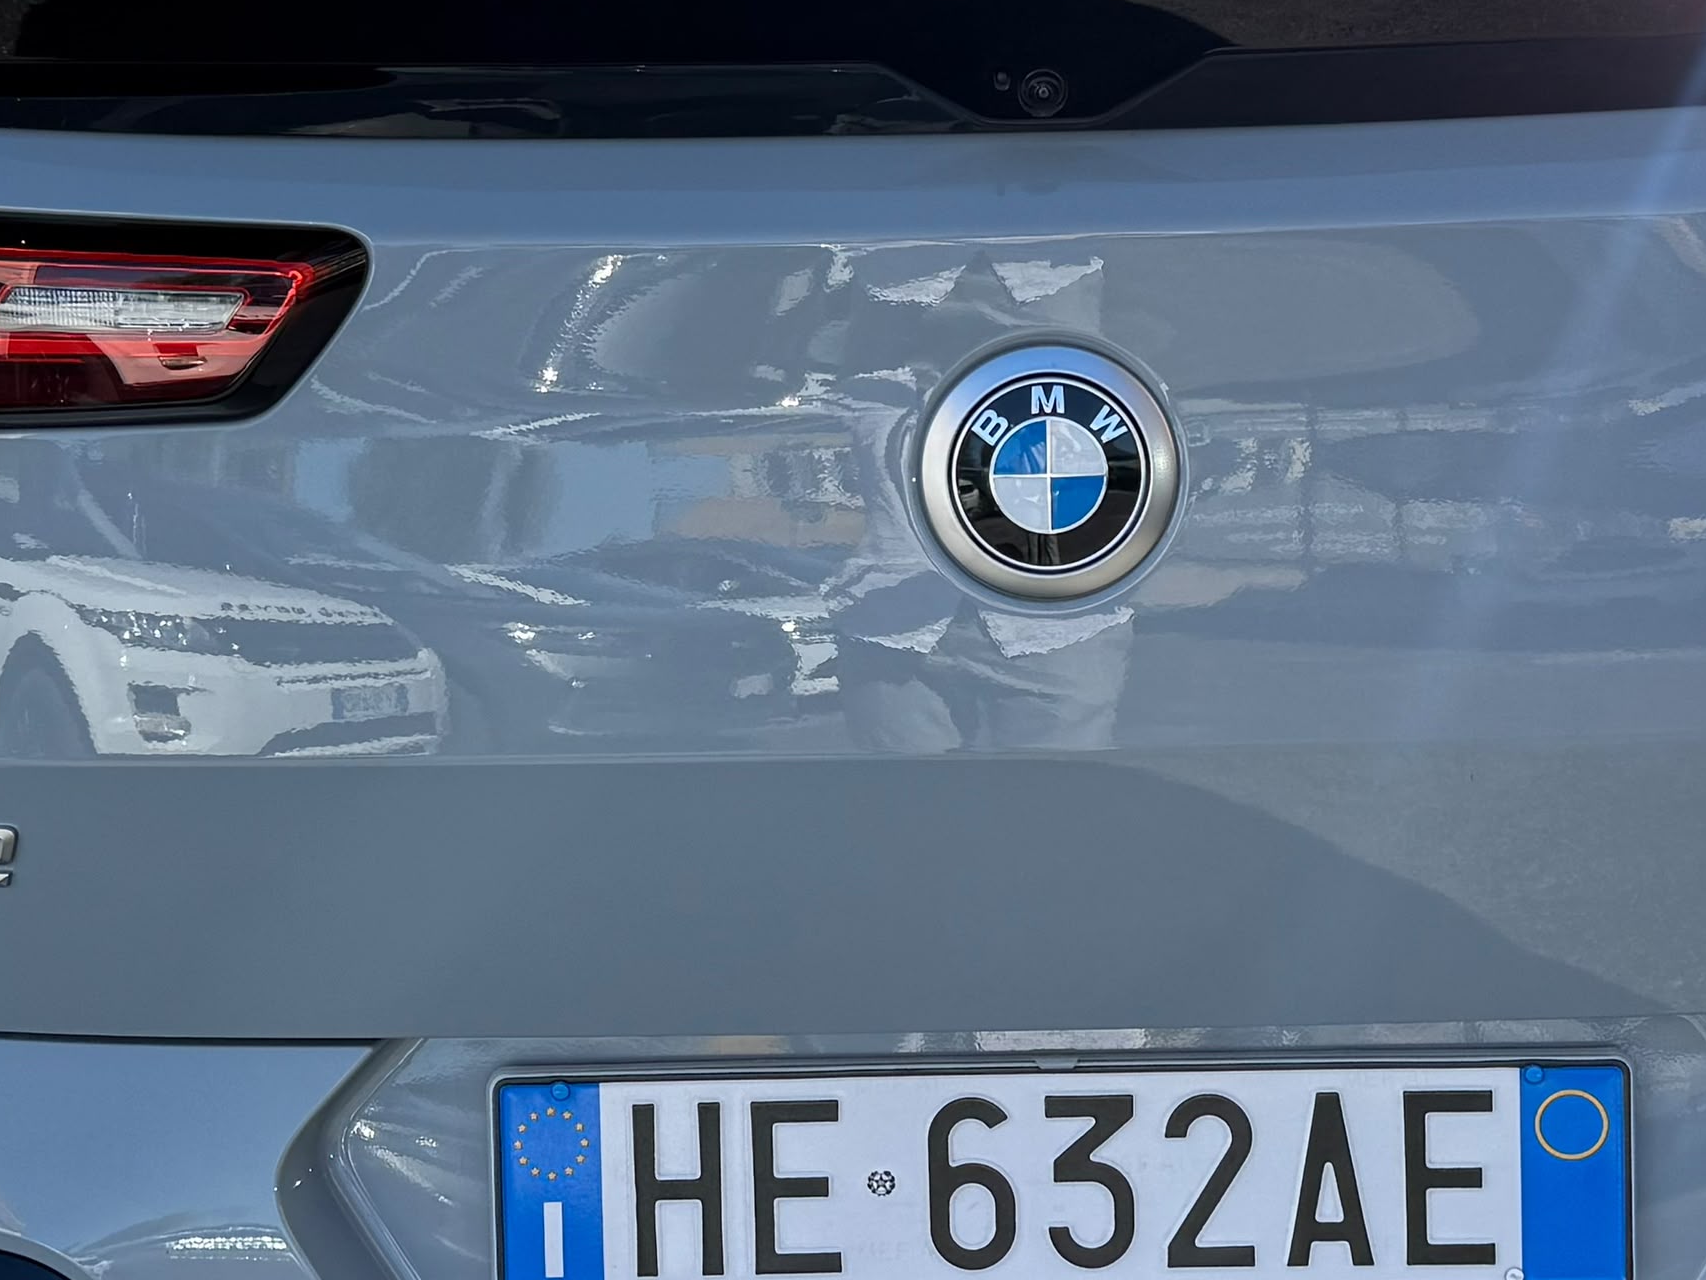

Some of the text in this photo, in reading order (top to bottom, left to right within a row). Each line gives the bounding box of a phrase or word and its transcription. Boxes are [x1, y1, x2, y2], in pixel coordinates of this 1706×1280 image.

[971, 385, 1128, 446] BMW
[543, 1089, 1498, 1278] I HE 632AE
